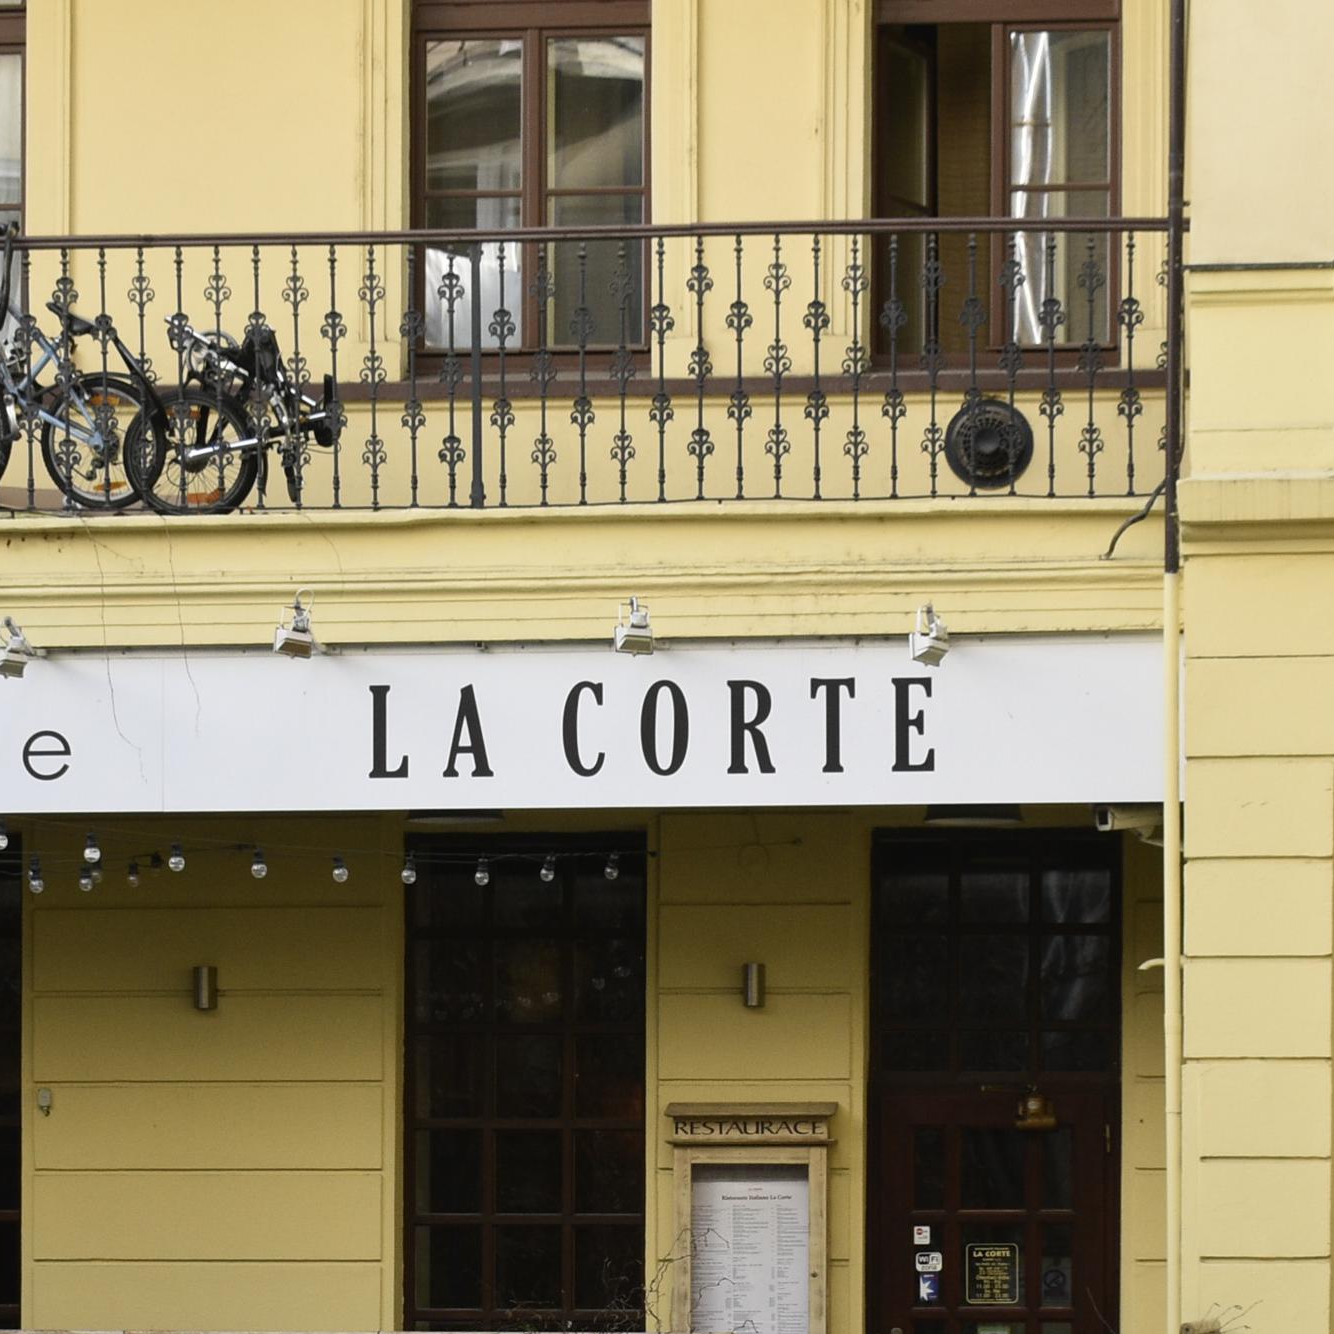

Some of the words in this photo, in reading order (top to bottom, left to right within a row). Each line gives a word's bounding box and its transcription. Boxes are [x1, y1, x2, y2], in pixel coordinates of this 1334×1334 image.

[368, 682, 495, 780] LA
[561, 676, 936, 778] CORTE
[674, 1119, 825, 1136] RESTAURACE
